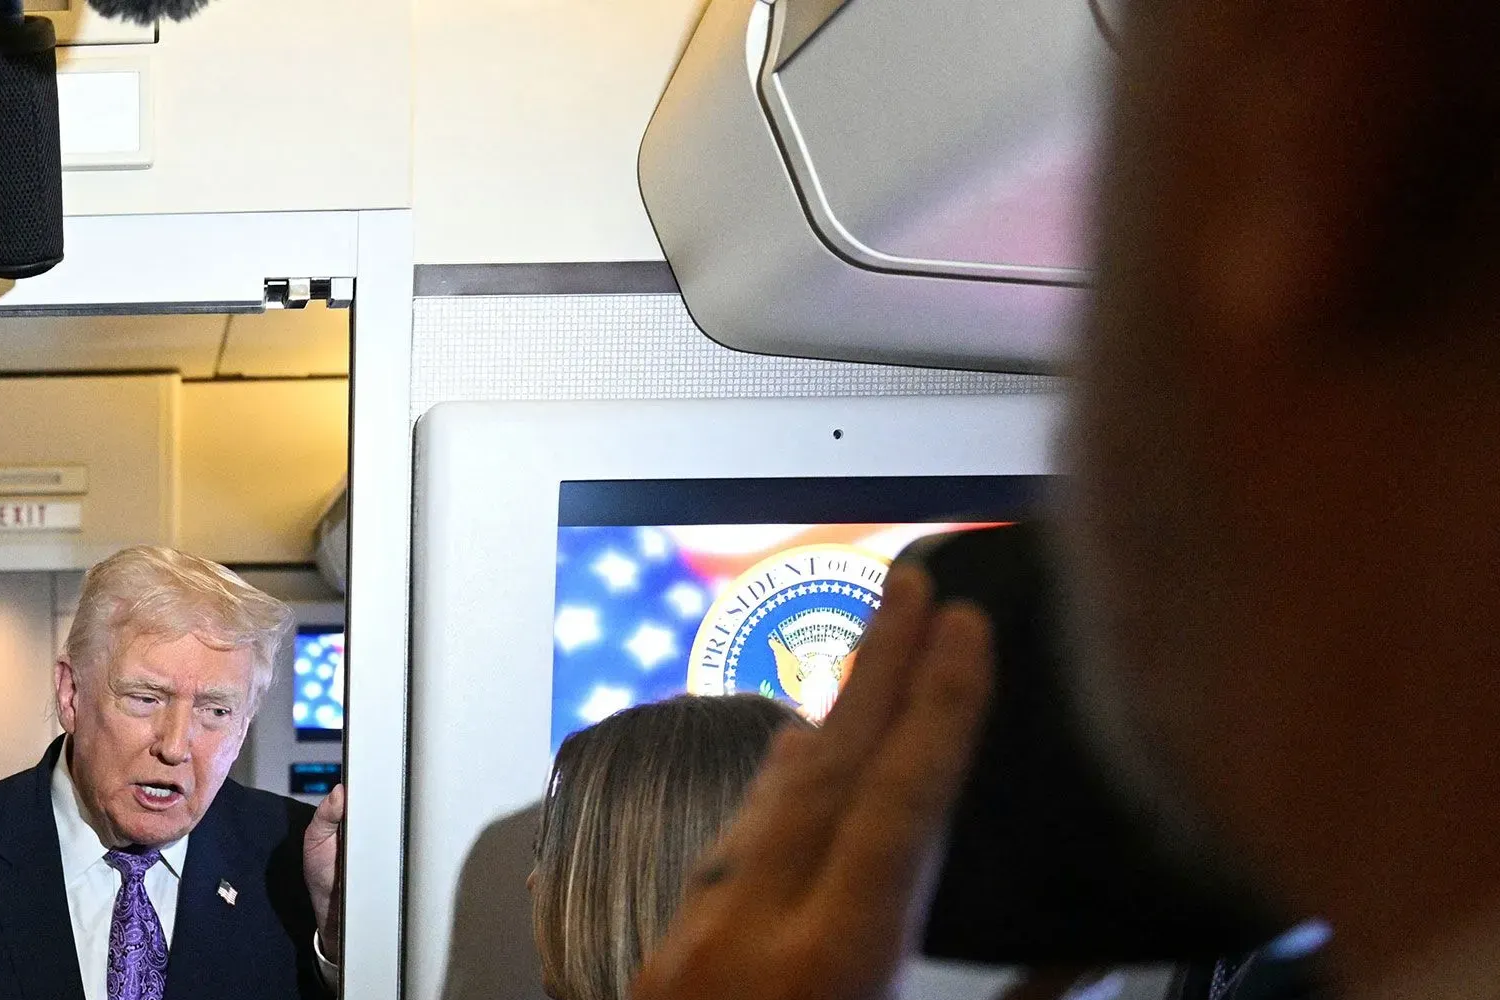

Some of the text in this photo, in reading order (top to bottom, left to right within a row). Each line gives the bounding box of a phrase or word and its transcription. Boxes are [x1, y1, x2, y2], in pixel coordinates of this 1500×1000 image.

[0, 504, 46, 526] EXIT
[702, 556, 884, 669] PRESIDENT OF TH
